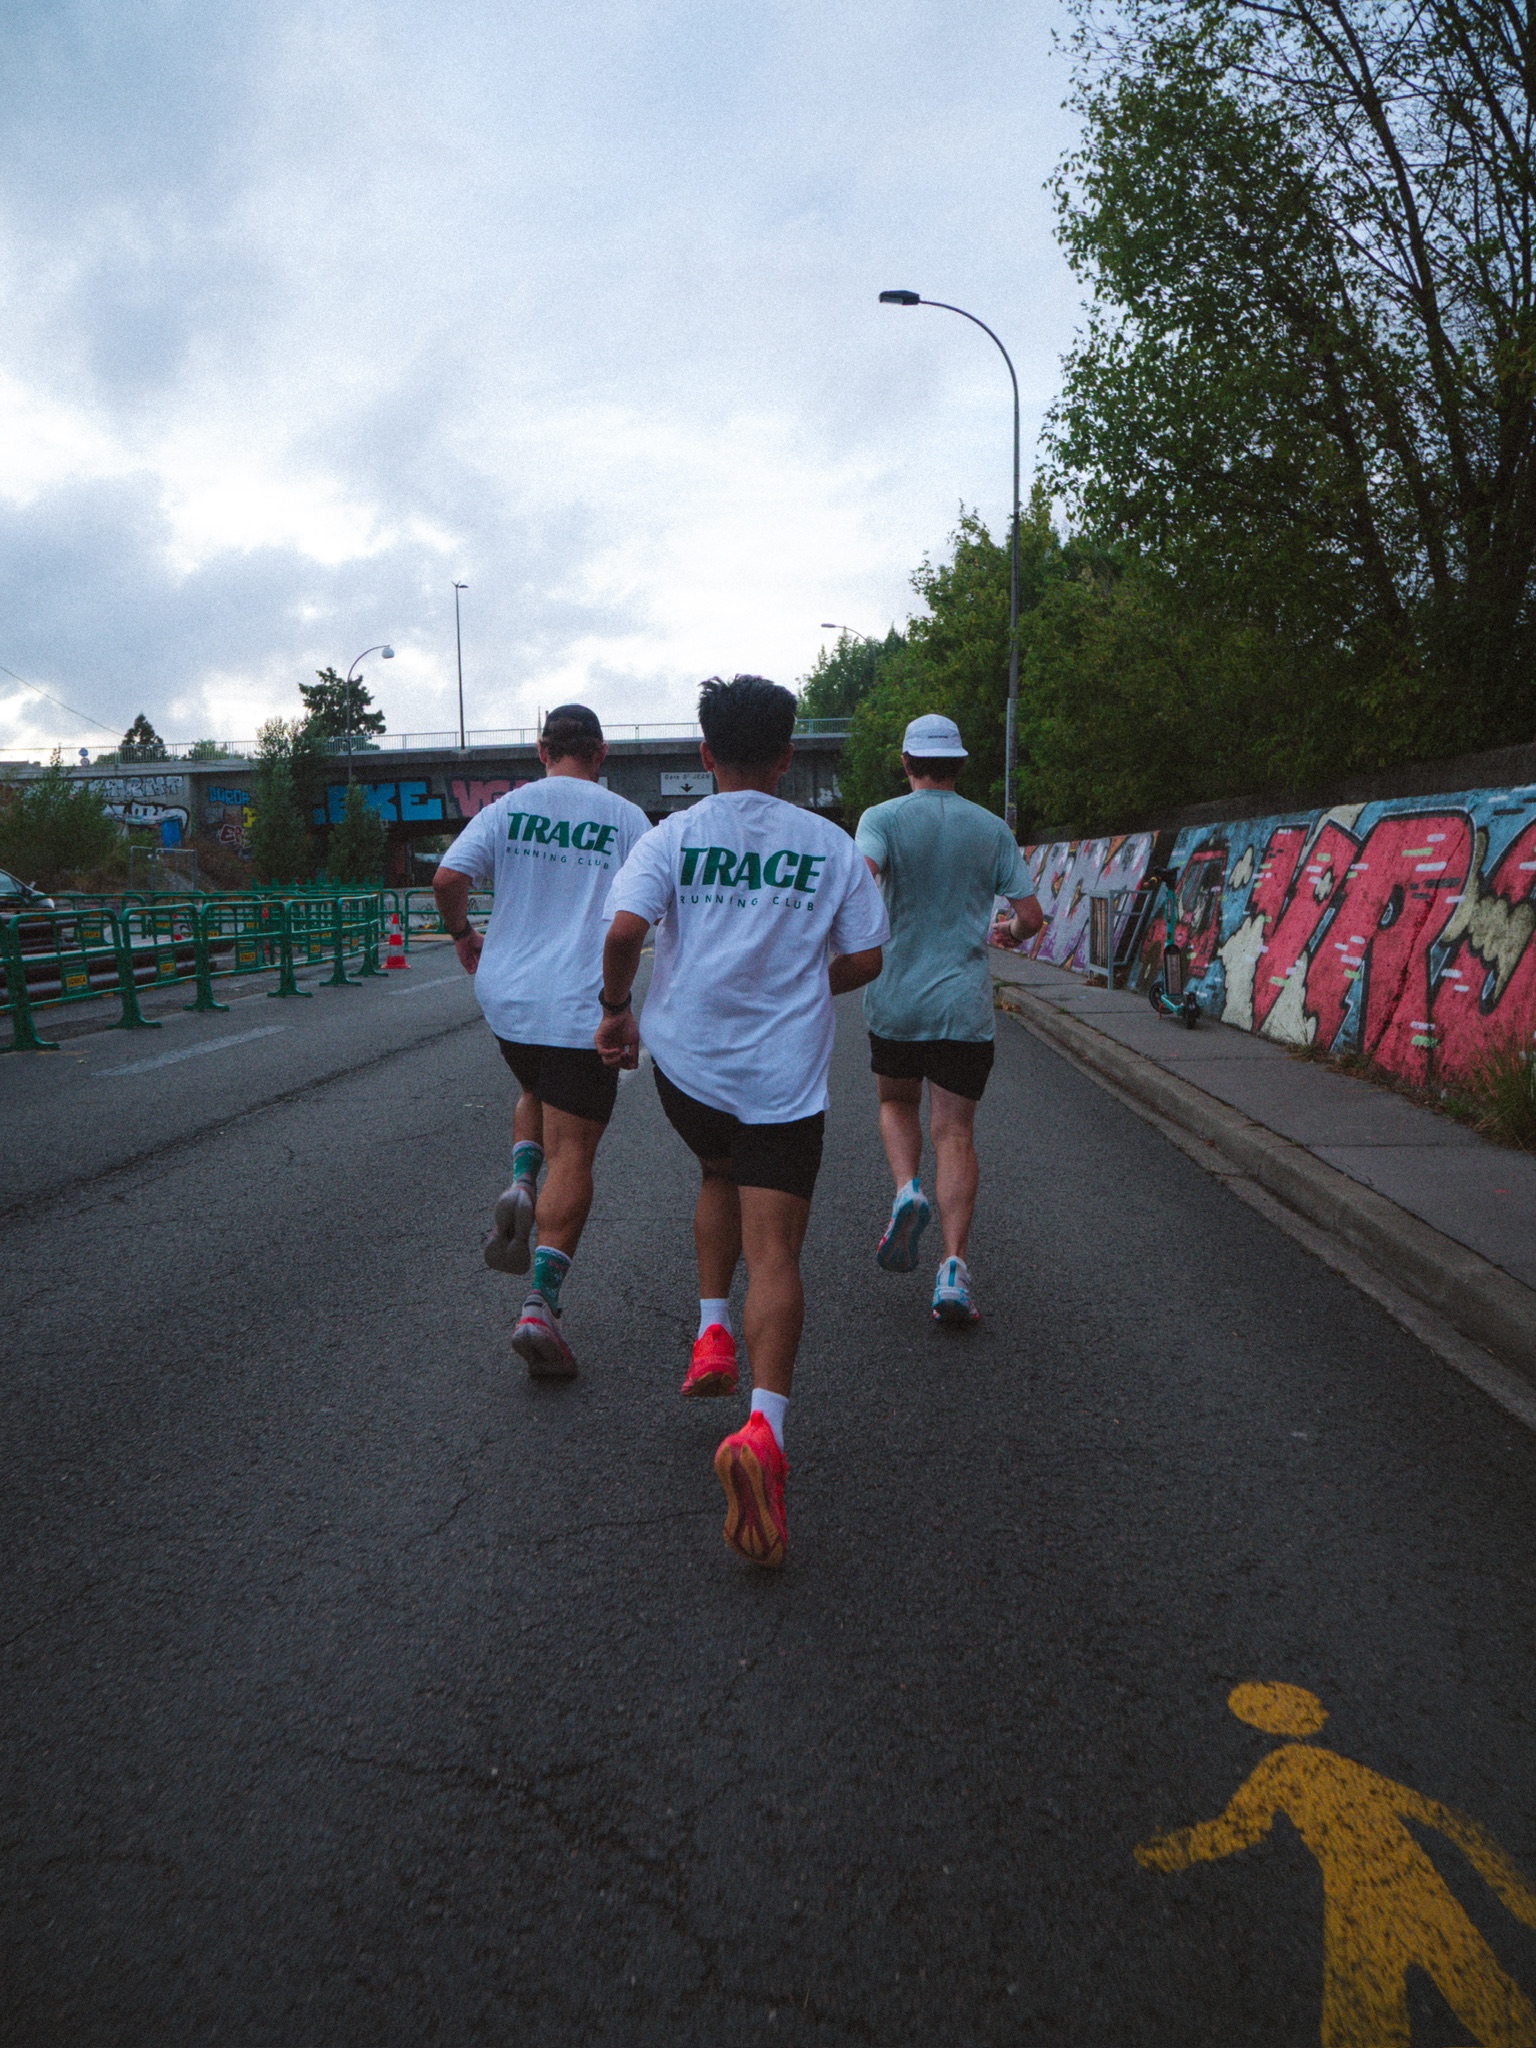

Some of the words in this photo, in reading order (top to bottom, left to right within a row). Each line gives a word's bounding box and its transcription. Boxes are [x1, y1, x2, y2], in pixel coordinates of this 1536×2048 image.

[507, 812, 619, 856] TRACE
[506, 846, 567, 863] RUNNING
[577, 857, 609, 870] CLUB
[680, 846, 826, 894] TRACE
[680, 895, 759, 908] RUNNING
[772, 896, 815, 911] CLUB
